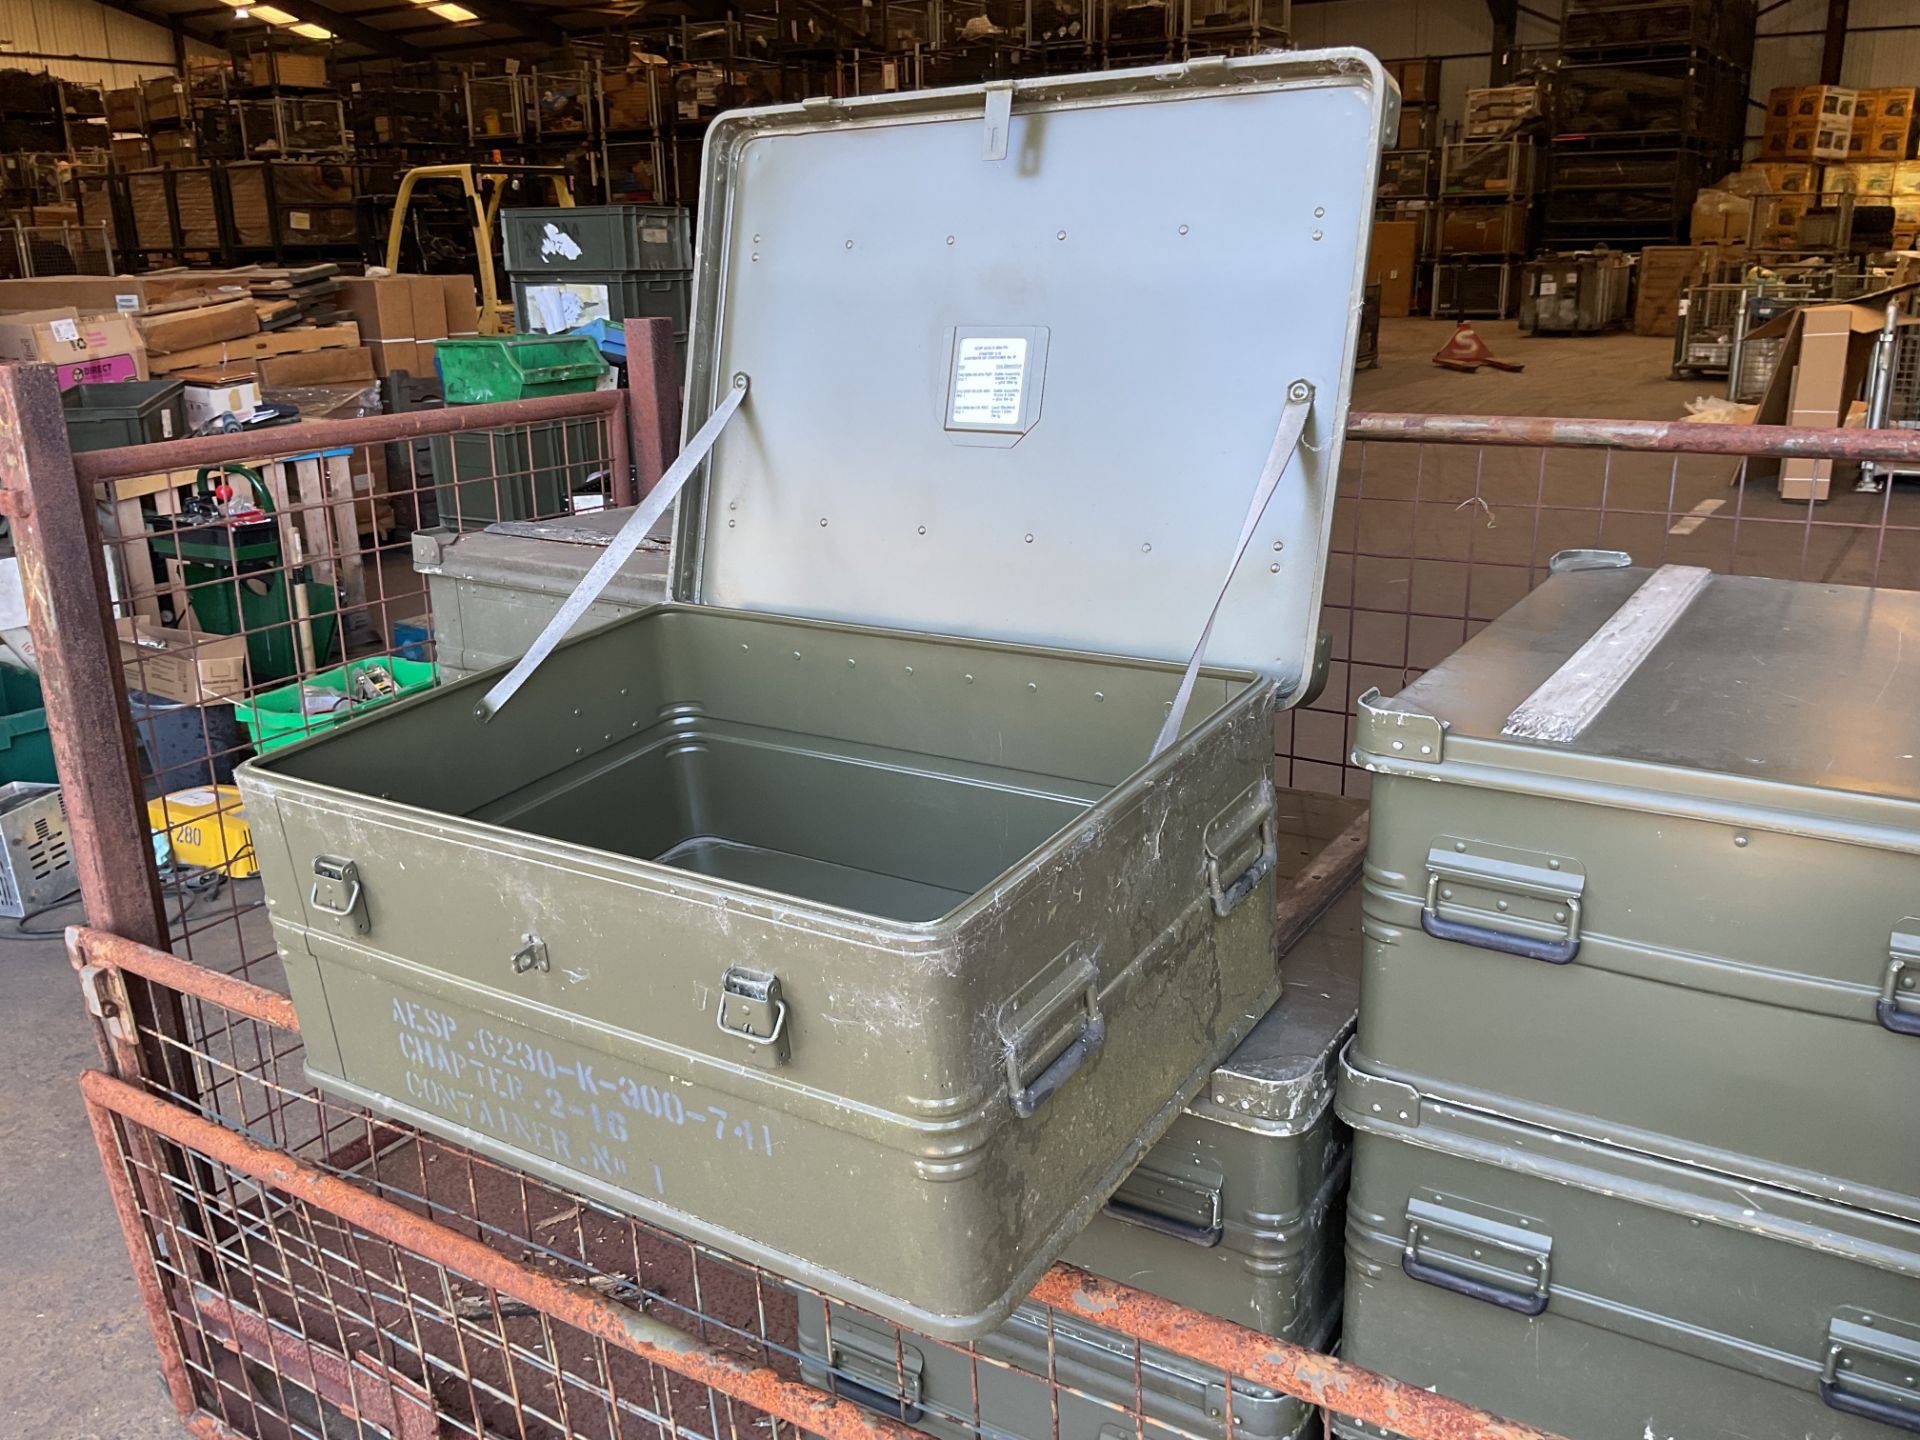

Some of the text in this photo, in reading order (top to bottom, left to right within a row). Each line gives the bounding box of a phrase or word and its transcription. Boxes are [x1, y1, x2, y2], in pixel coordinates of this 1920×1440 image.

[84, 363, 112, 375] DIRECT
[392, 997, 457, 1042] AESP
[404, 1070, 571, 1159] CONTAINER
